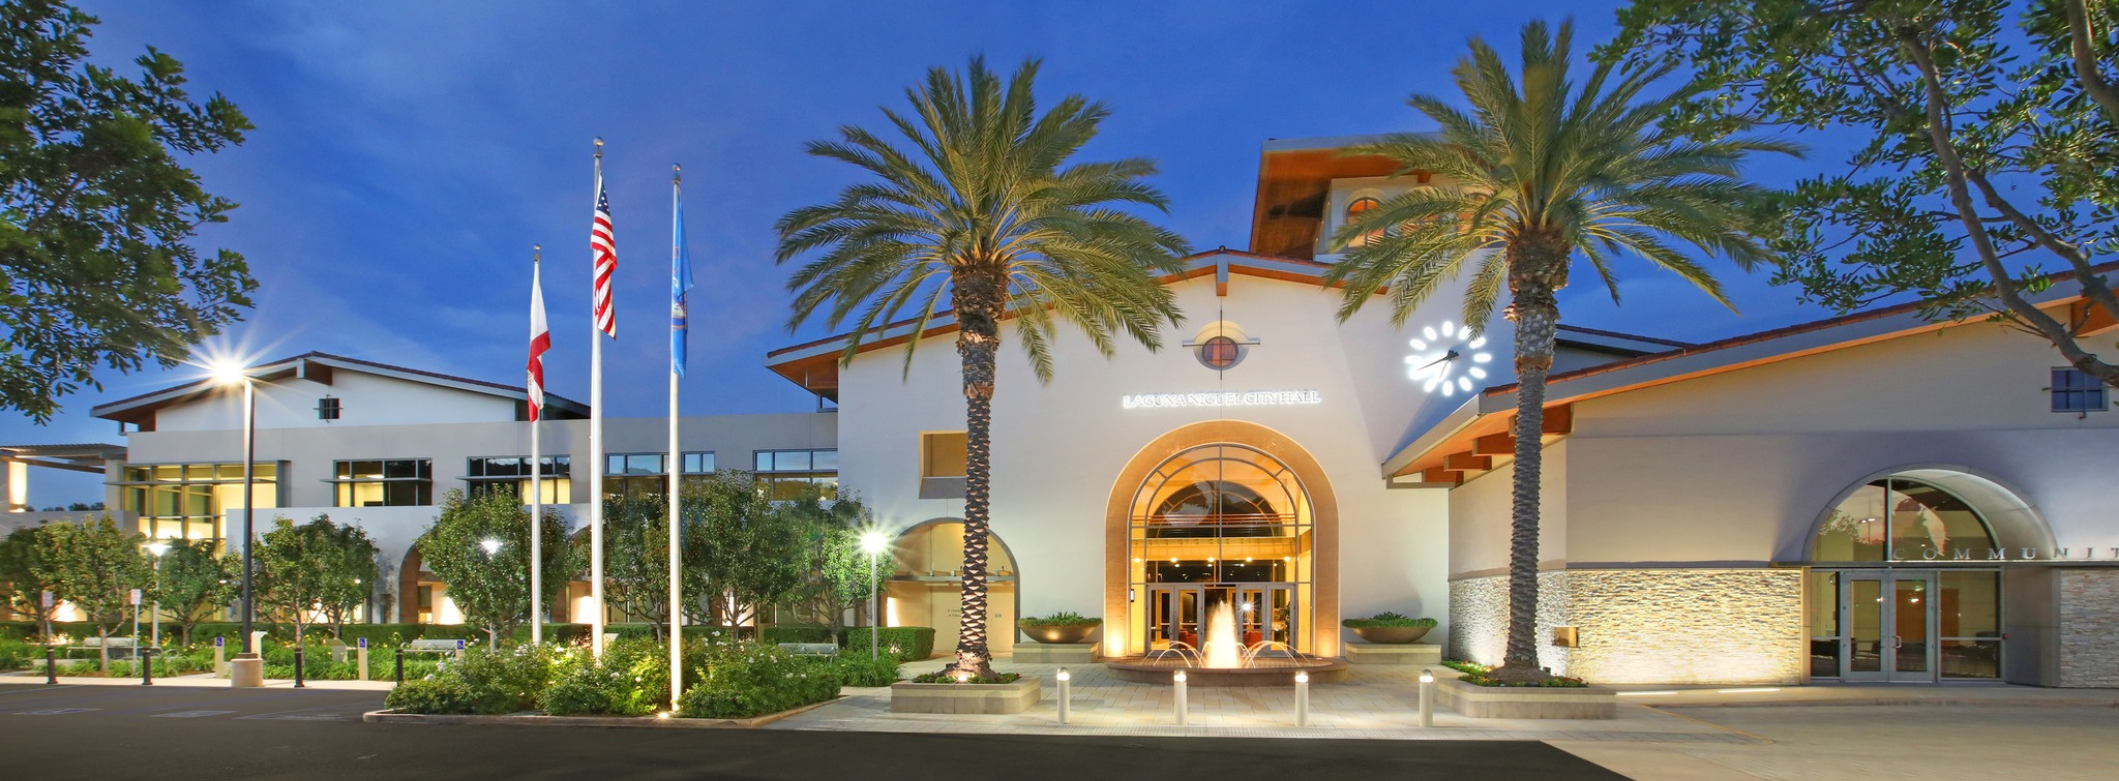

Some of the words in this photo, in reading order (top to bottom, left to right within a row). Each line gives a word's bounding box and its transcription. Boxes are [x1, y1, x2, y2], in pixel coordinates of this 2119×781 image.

[1123, 394, 1187, 409] LAGUNA
[1188, 392, 1242, 407] NIGUEL
[1244, 391, 1278, 406] CITY
[1279, 389, 1322, 405] HALL
